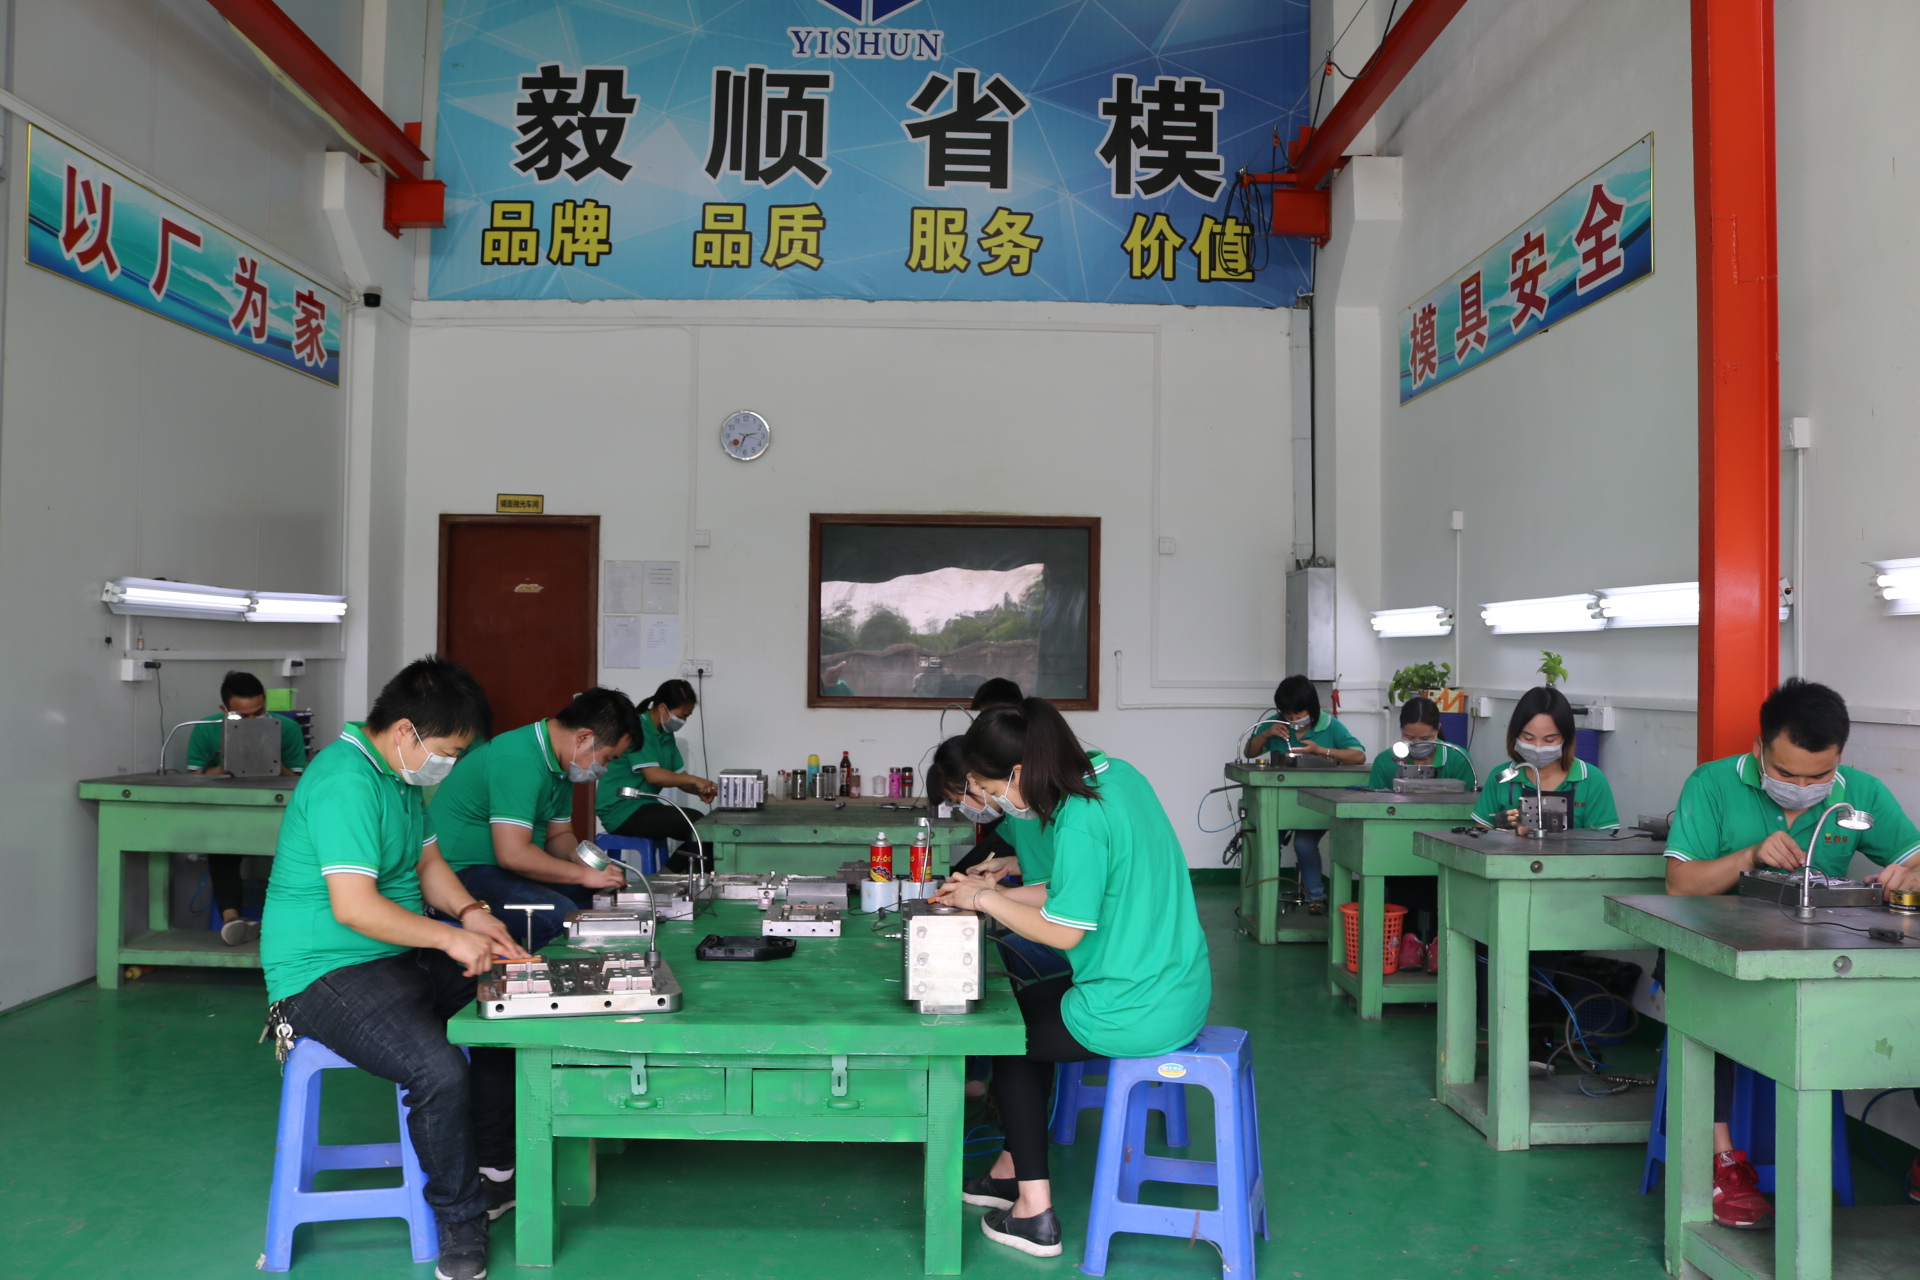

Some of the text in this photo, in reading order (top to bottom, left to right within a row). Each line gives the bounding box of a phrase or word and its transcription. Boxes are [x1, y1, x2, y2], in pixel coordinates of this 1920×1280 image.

[790, 30, 941, 57] YISHUN
[512, 64, 1226, 200] 毅顺省模
[61, 164, 327, 364] 以厂为家
[482, 200, 1255, 282] 品牌 品质 服务 价值
[1409, 183, 1625, 386] 模具安全
